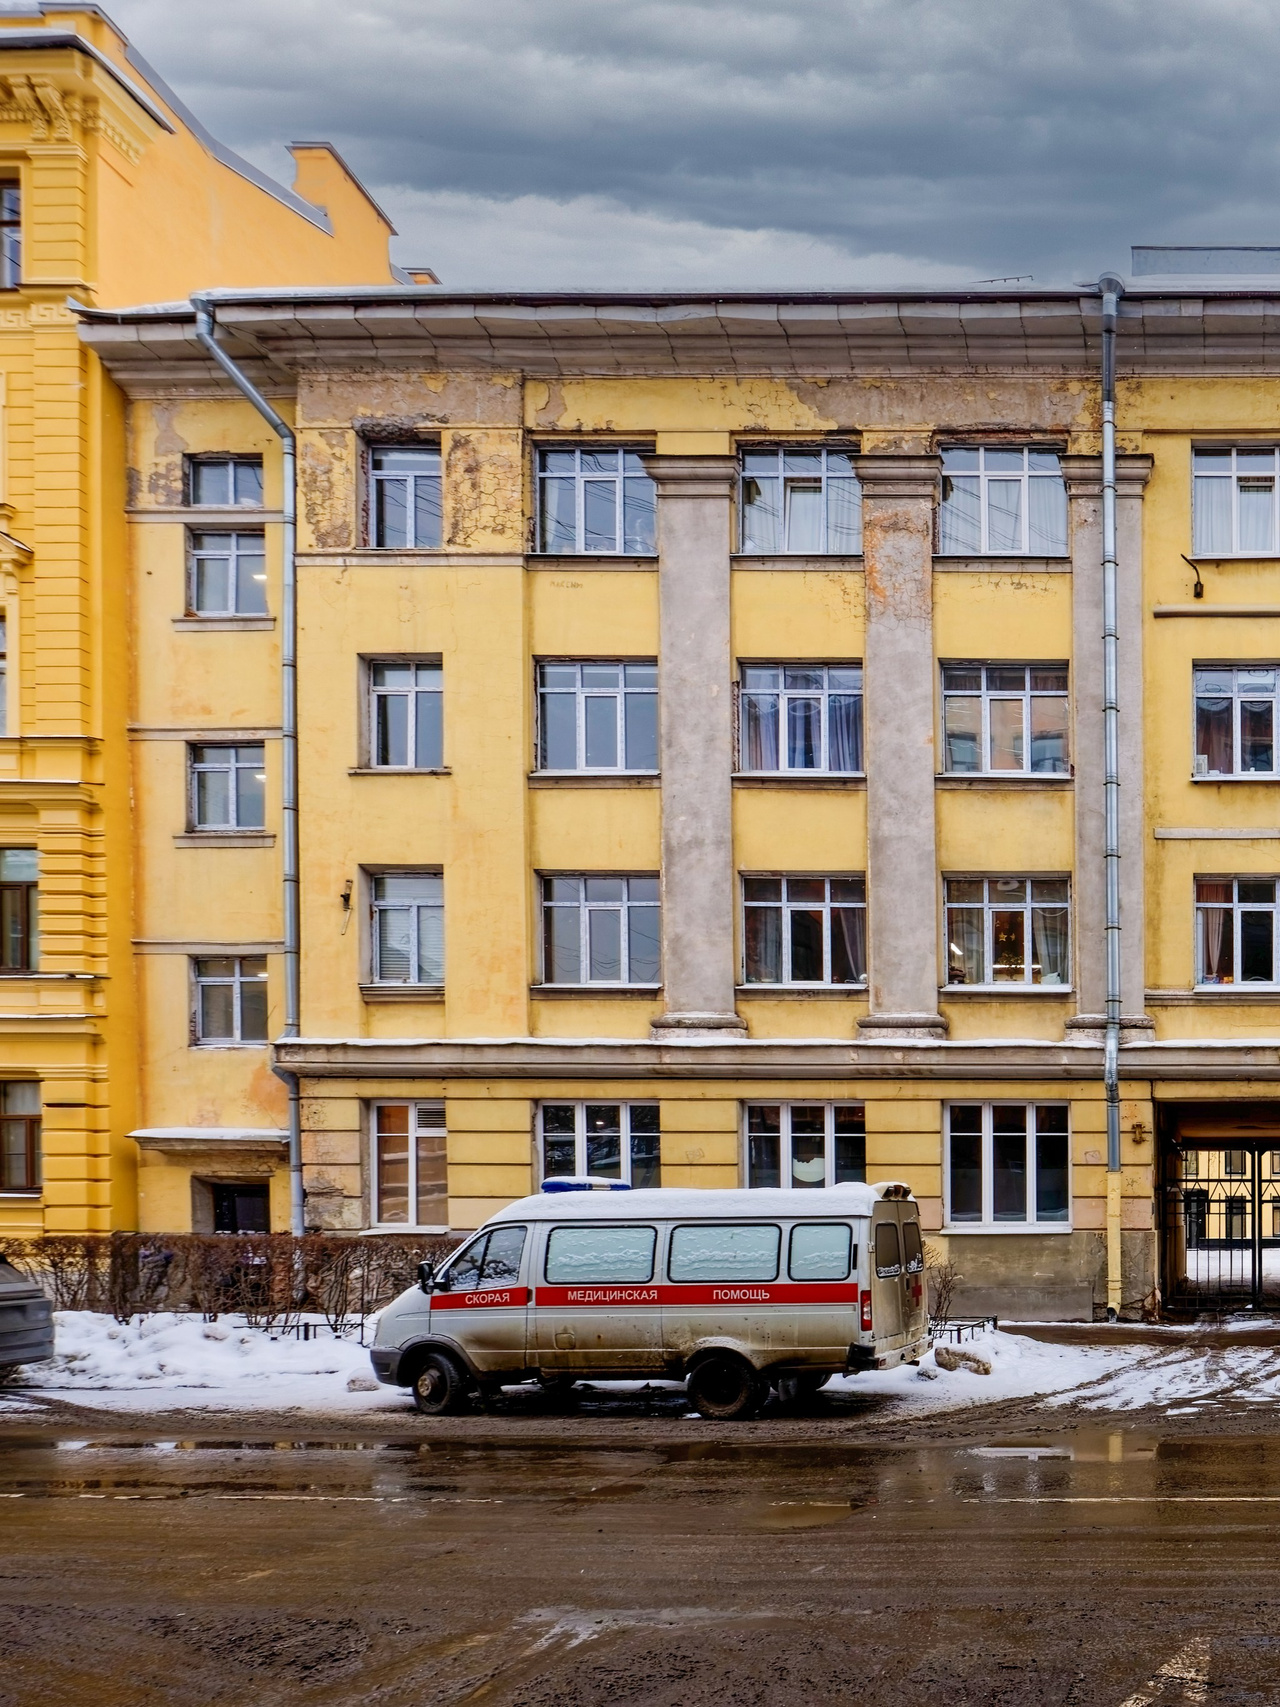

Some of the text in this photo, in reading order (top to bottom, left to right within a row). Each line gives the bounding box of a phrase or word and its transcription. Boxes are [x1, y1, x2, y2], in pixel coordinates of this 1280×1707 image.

[465, 1289, 770, 1304] СКОРАЯ МЕДИЦИНСКАЯ ПОМОЩЬ
